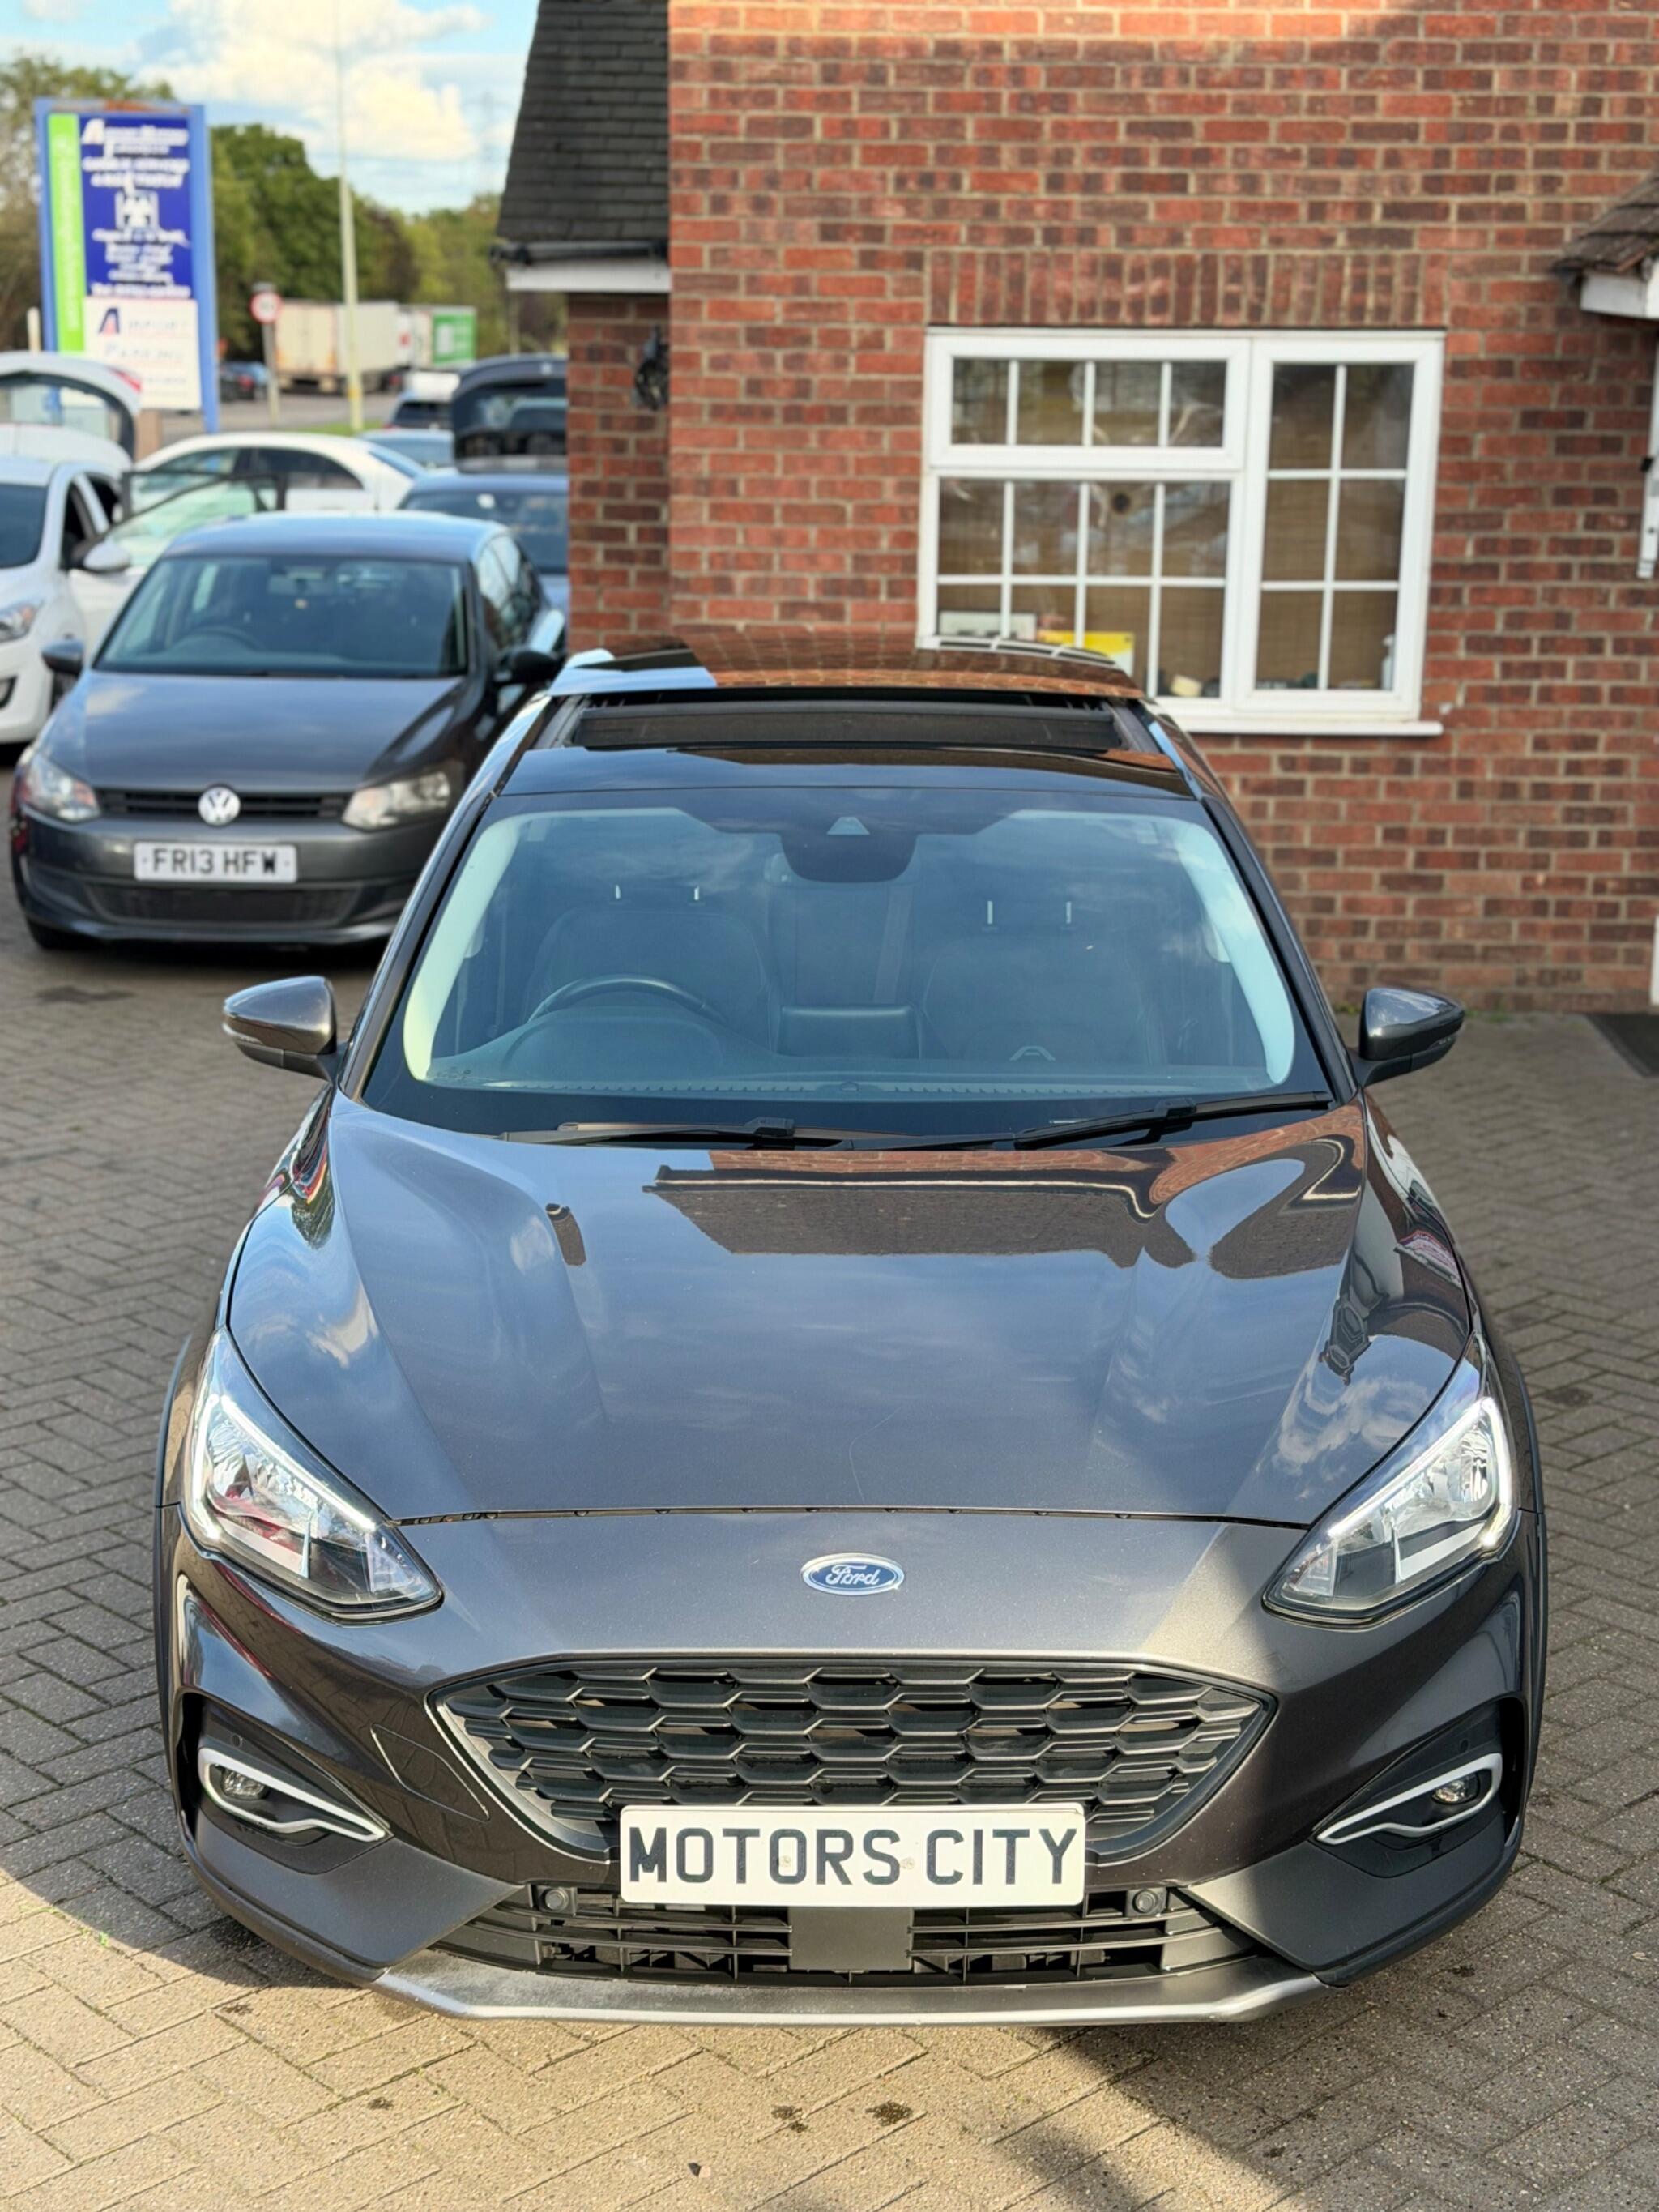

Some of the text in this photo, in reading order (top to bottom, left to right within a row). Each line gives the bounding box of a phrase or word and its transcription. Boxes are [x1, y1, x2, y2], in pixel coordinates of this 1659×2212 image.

[153, 848, 276, 875] FR13 HFW
[825, 1564, 881, 1585] Ford
[629, 1827, 1077, 1886] MOTORS CITY
